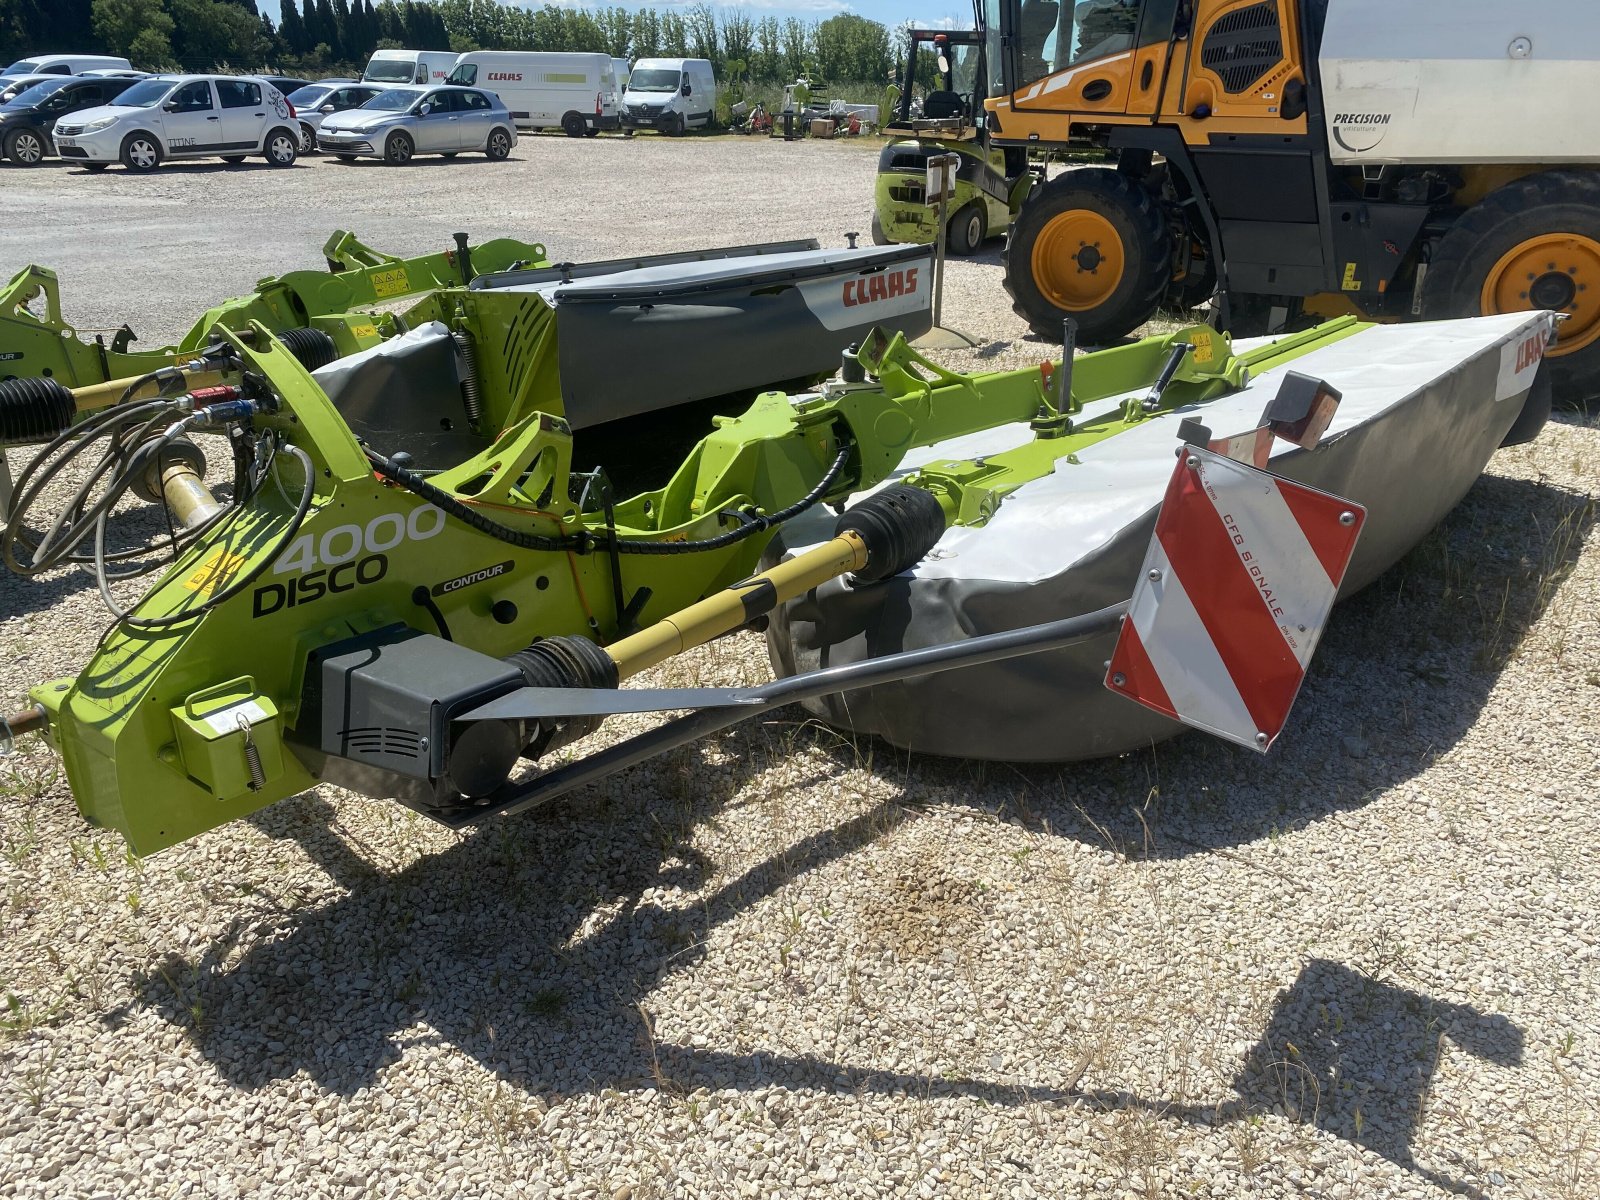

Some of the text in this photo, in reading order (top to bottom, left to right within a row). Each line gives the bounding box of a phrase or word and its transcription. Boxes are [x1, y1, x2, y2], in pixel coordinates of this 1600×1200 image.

[487, 72, 523, 81] CLAAS
[1333, 113, 1391, 124] PRECISION
[168, 137, 196, 147] TITINE
[842, 267, 919, 307] CLAAS
[273, 502, 446, 575] 4000
[1223, 514, 1244, 546] CFG
[253, 553, 388, 619] DISCO
[443, 564, 504, 593] CONTOUR
[1280, 625, 1290, 637] DIN
